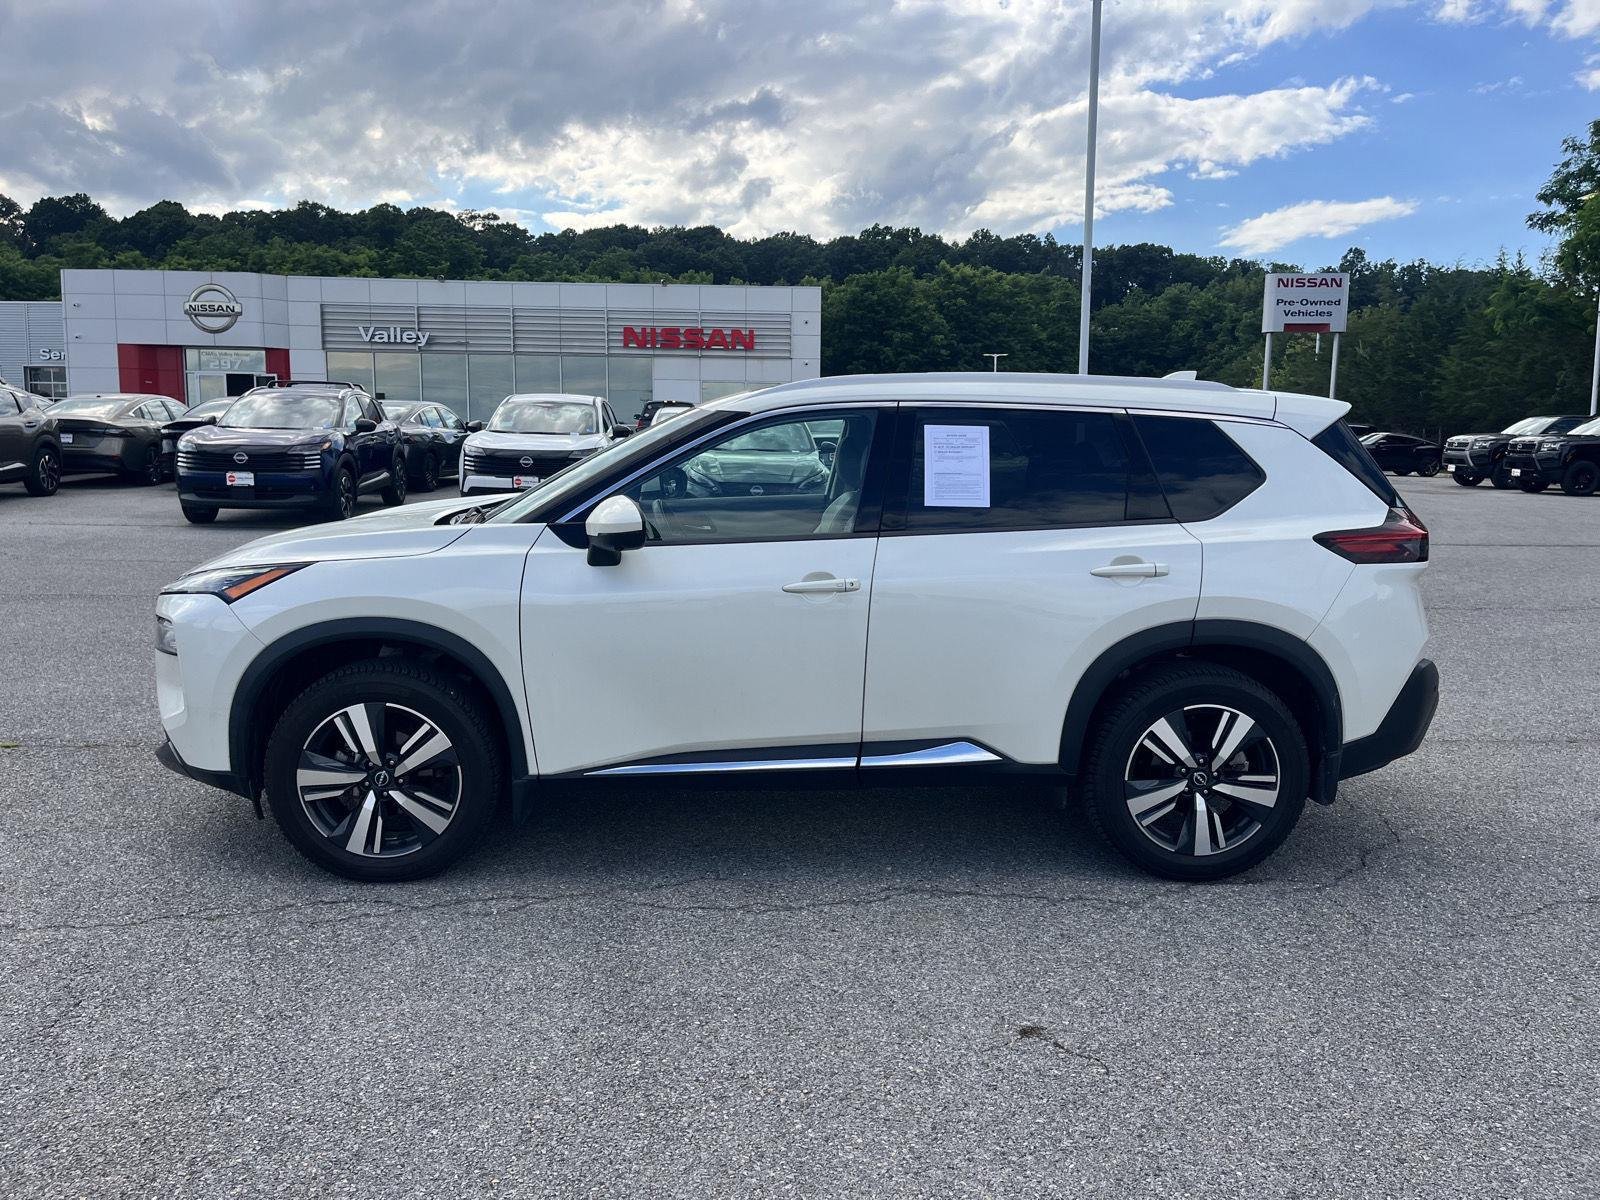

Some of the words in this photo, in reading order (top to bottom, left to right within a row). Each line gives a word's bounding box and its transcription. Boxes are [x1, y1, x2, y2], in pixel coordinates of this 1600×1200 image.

[1277, 277, 1342, 288] NISSAN
[1276, 298, 1341, 306] Pre-Owned
[188, 304, 235, 312] NISSAN
[1283, 309, 1333, 317] Vehicles
[358, 326, 430, 347] Valley
[623, 326, 756, 351] NISSAN
[209, 359, 243, 369] 297
